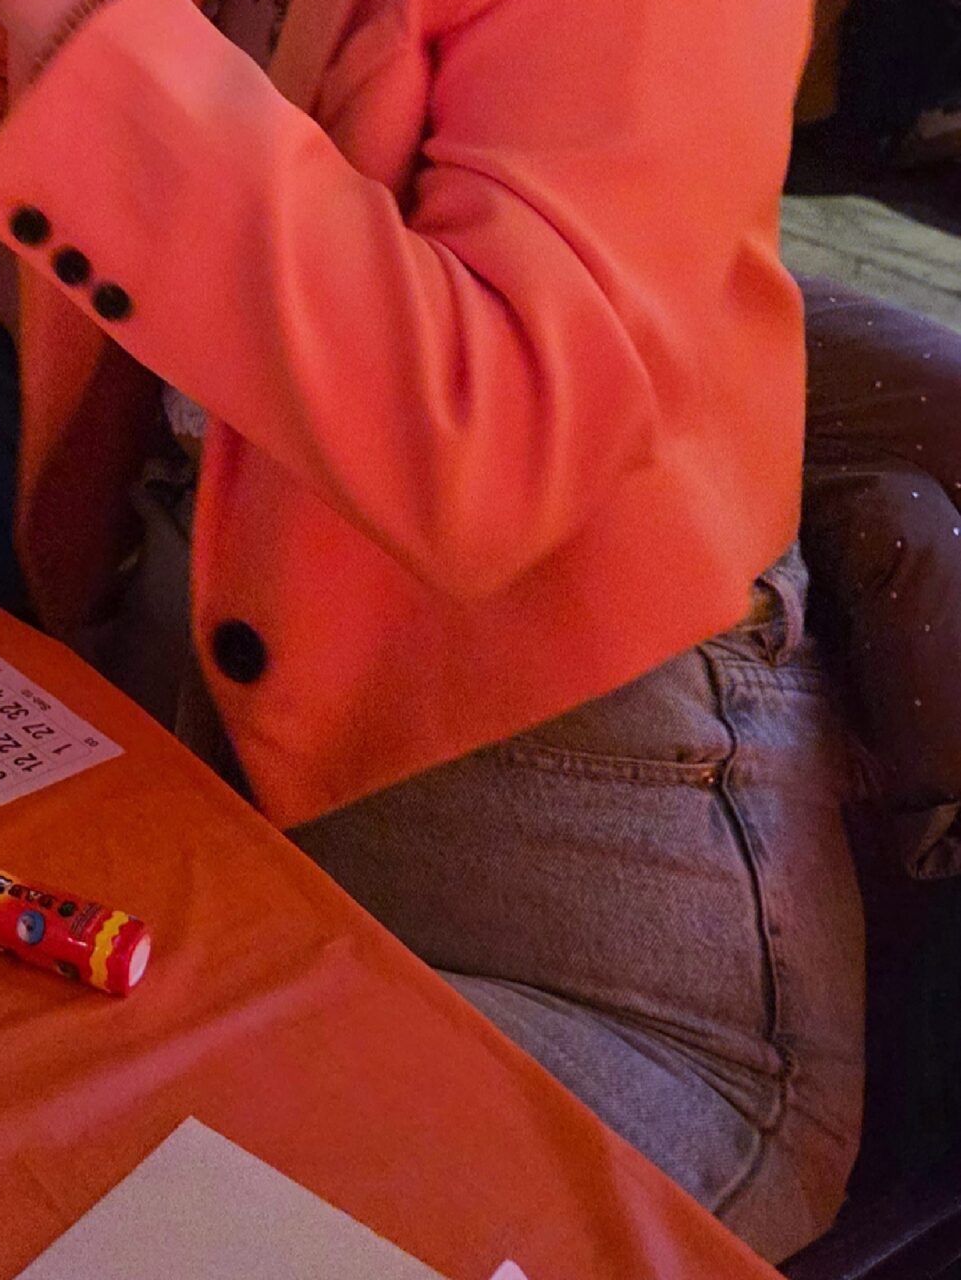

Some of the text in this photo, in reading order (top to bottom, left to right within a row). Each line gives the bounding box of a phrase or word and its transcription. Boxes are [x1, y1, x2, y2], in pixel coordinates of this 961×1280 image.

[22, 723, 55, 740] 27
[51, 743, 73, 755] 1
[13, 752, 44, 772] 12
